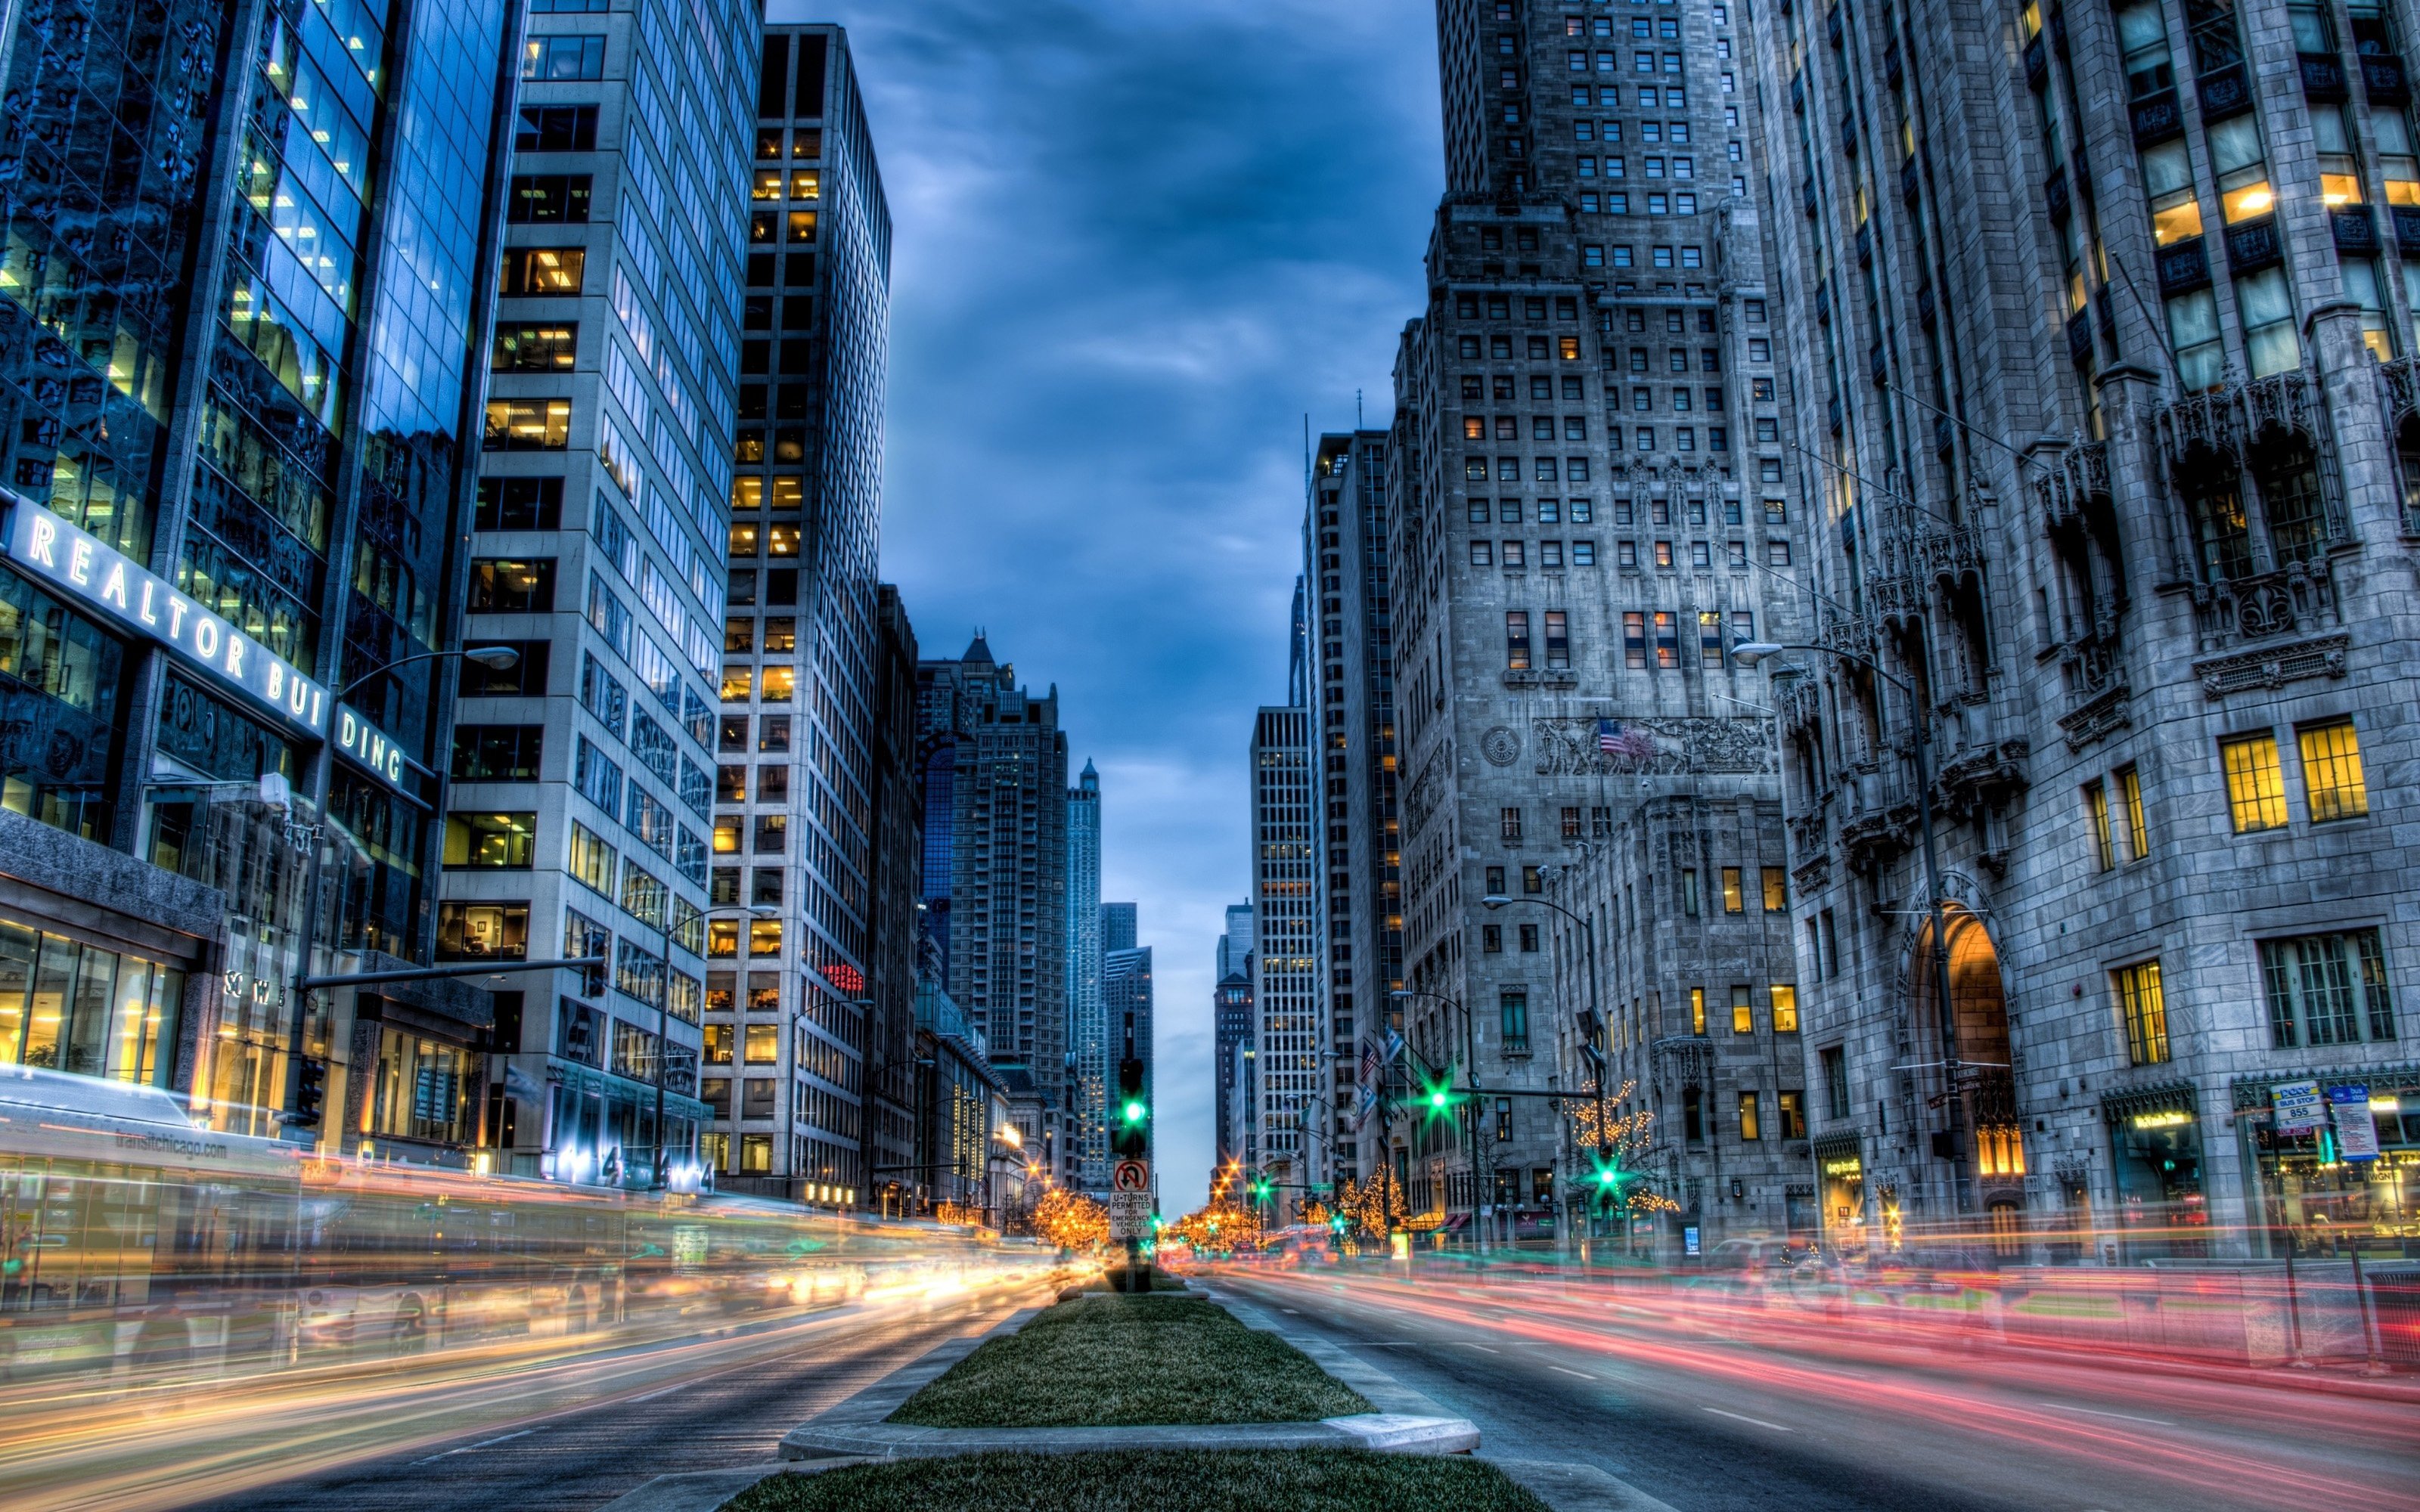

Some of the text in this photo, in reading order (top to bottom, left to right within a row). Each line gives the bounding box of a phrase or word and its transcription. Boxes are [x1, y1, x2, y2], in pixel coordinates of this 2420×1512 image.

[28, 513, 402, 784] REALTOR BUIDING
[2296, 1096, 2316, 1105] STOP
[2290, 1108, 2309, 1117] 855
[115, 1128, 227, 1160] transitchicago.com
[1113, 1194, 1150, 1202] U-TURNS
[1120, 1227, 1142, 1235] ONLY
